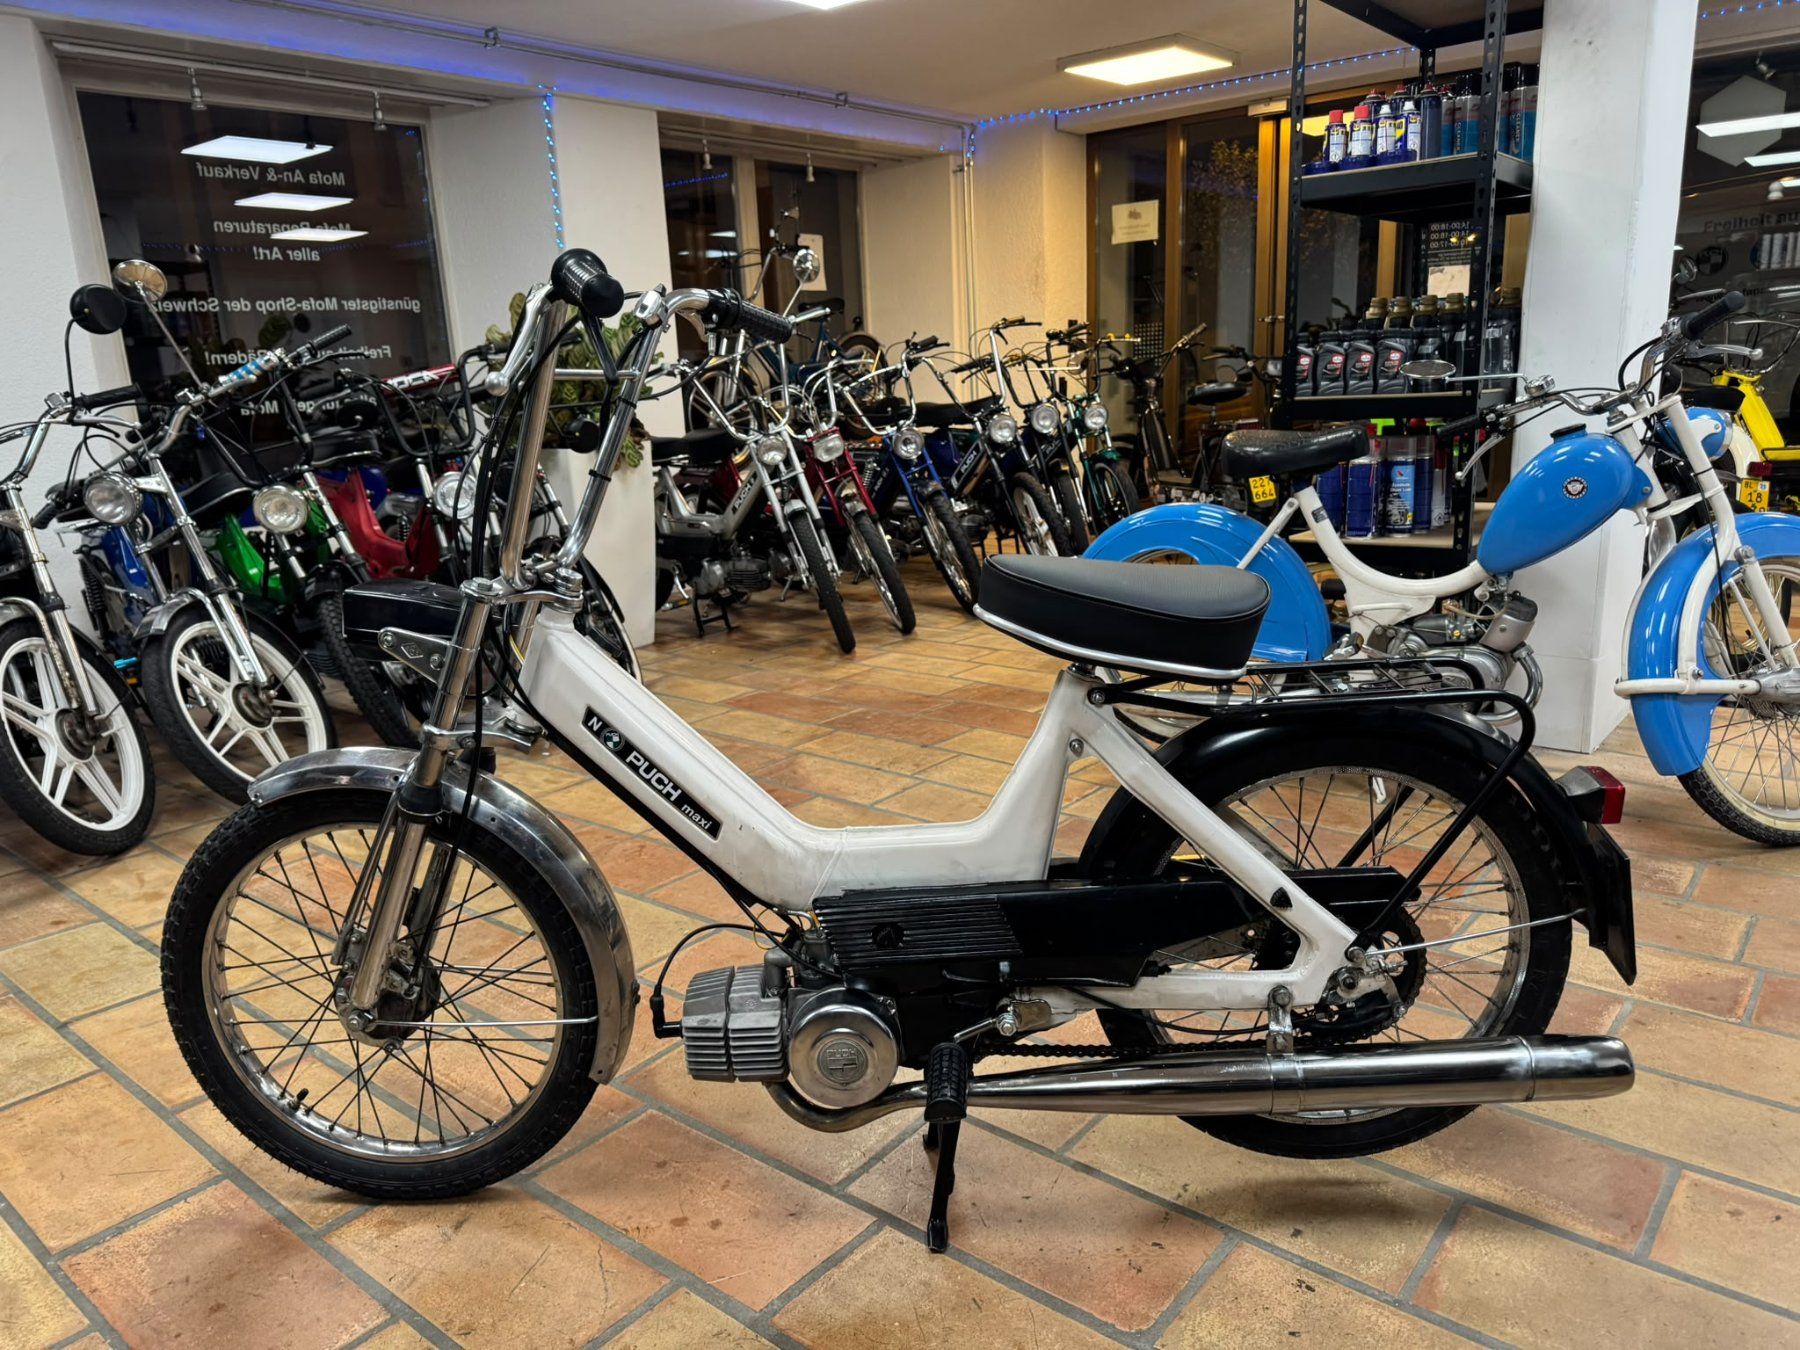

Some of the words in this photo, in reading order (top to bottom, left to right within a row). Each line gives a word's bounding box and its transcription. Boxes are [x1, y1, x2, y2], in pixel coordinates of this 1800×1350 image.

[1747, 491, 1763, 503] 18
[587, 716, 603, 732] N
[625, 750, 682, 802] PUCH
[681, 803, 713, 830] maxi
